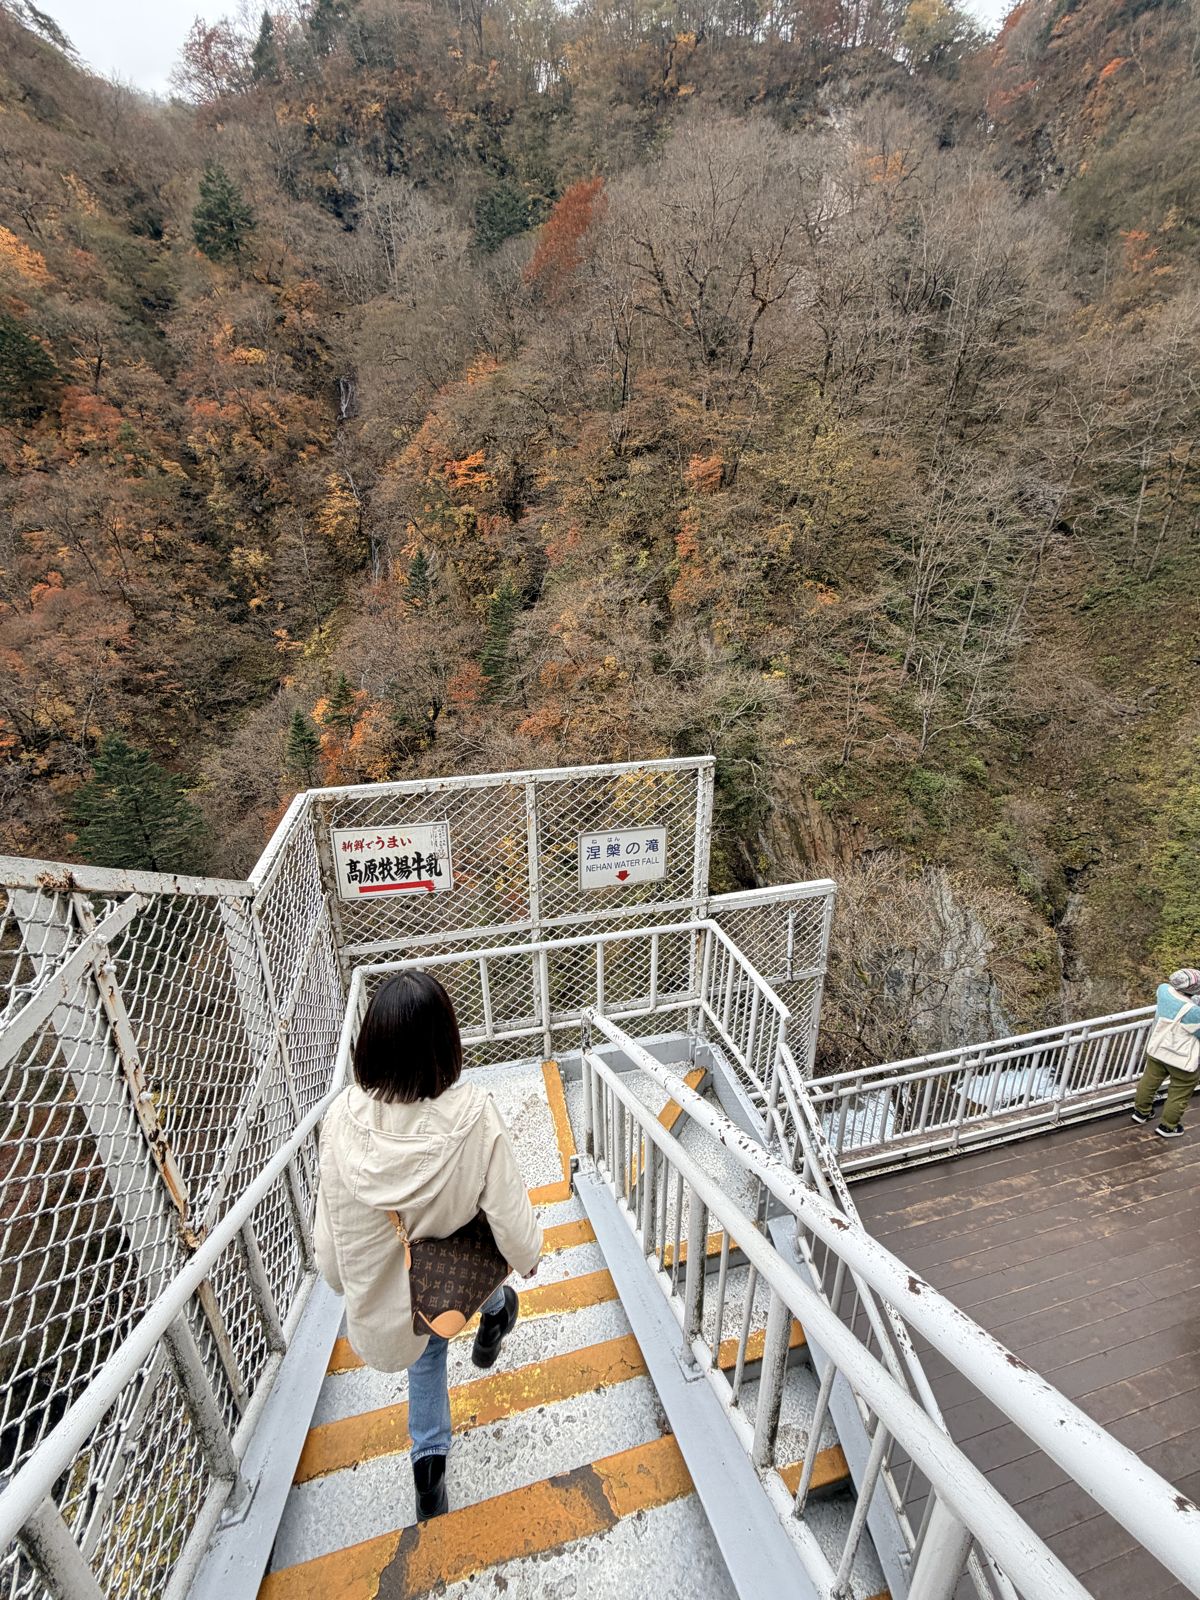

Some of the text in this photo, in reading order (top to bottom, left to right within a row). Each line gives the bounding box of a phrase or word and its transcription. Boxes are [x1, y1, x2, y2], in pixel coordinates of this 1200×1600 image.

[341, 835, 412, 853] 新鮮でうまい
[586, 857, 659, 872] NEHAN WATER FALL
